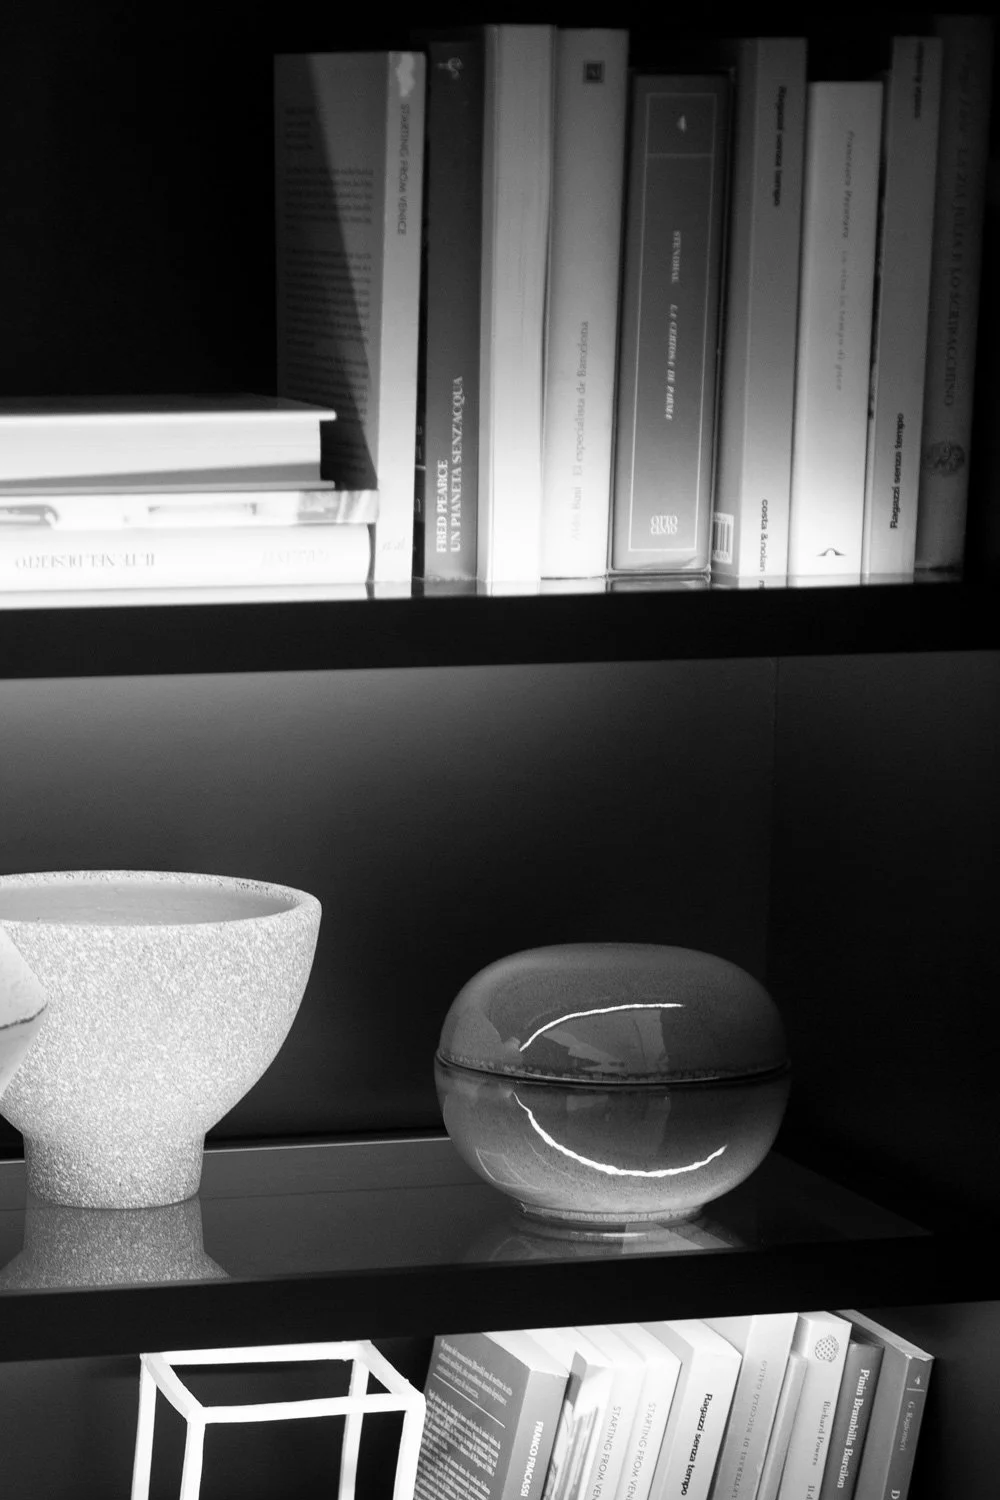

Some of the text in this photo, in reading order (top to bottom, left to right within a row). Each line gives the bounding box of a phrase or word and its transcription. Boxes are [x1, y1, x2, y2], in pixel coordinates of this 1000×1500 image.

[397, 104, 409, 235] STARTING FROM VENICE
[450, 375, 465, 552] UN PIANETA SENZ'ACQUA
[890, 412, 905, 528] Ragazzi senza tempo
[435, 459, 449, 552] FRED PEARCE
[760, 499, 768, 529] costa
[603, 1405, 621, 1451] STARTING
[638, 1401, 657, 1448] STARTING
[816, 1399, 831, 1434] Richard
[835, 1367, 870, 1490] Pinin Brambilla Barcilon
[519, 1420, 544, 1497] FRANCO FRACASSI
[630, 1448, 646, 1479] FROM
[679, 1392, 713, 1496] Ragazzi senza tempo
[742, 1436, 751, 1448] DI
[810, 1436, 824, 1467] Powers
[594, 1453, 610, 1482] FROM
[806, 1484, 816, 1492] Il
